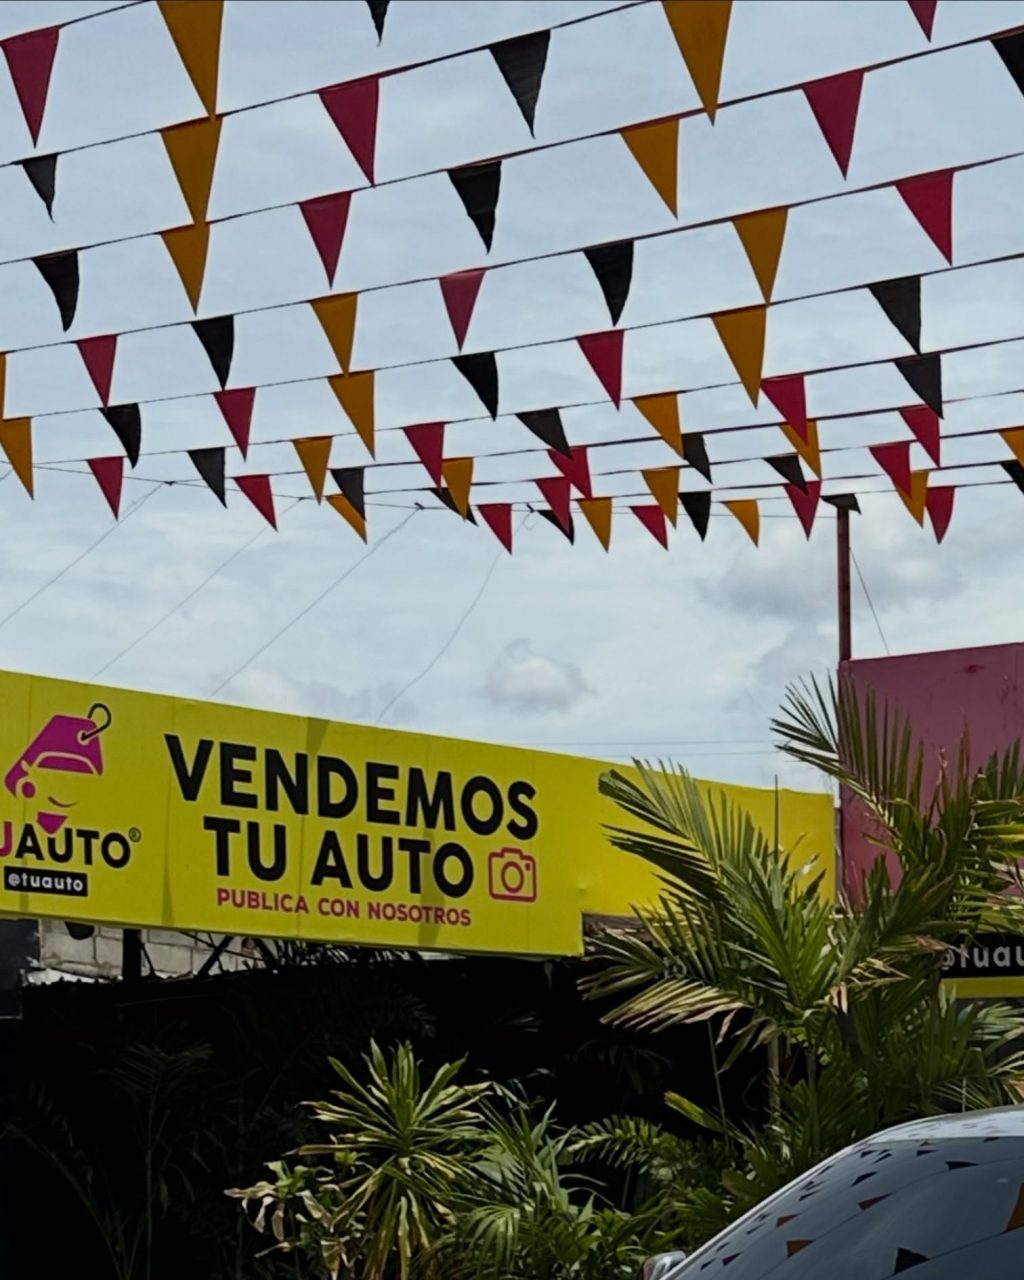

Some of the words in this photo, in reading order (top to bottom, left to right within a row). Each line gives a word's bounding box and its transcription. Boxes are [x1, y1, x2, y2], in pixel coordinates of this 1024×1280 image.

[164, 734, 538, 841] VENDEMOS
[8, 872, 84, 892] @tuauto
[203, 816, 287, 882] TU
[310, 829, 475, 898] AUTO
[216, 888, 309, 914] PUBLICA
[317, 898, 360, 919] CON
[367, 901, 472, 926] NOSOTROS
